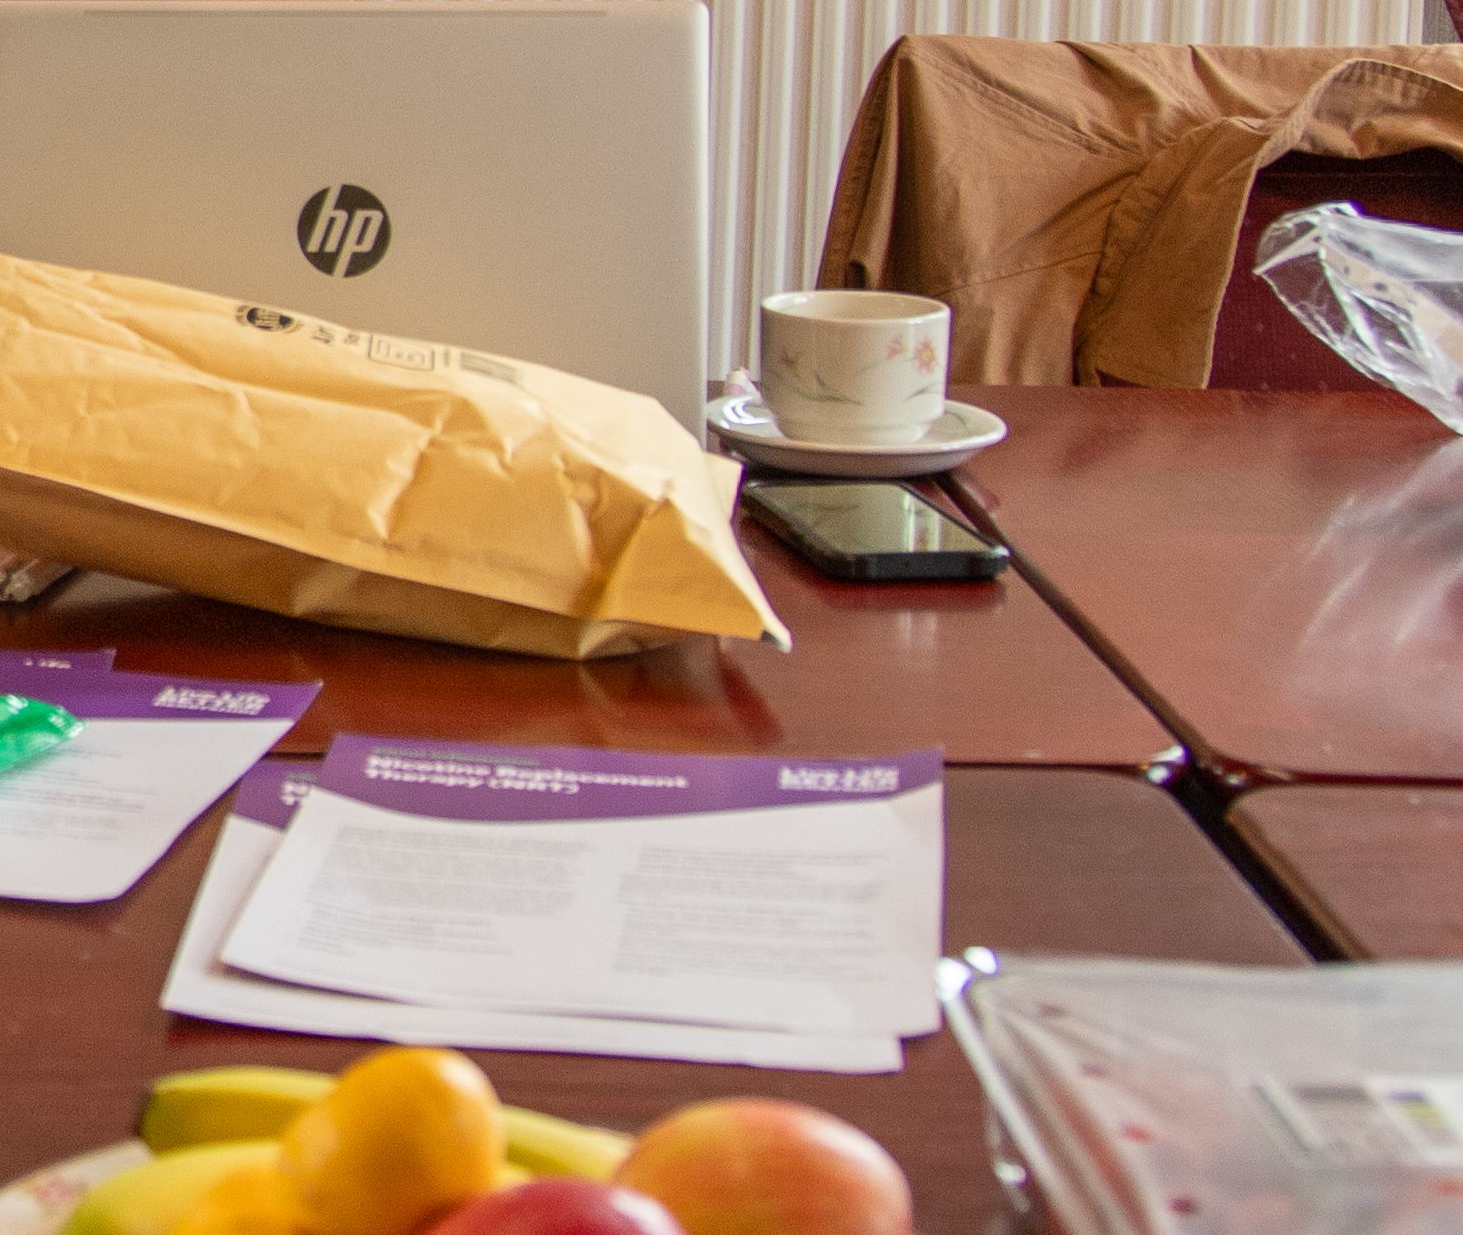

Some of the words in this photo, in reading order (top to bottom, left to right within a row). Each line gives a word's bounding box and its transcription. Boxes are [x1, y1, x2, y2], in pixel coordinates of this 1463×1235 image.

[303, 184, 387, 278] hp
[364, 766, 486, 789] Therapy
[489, 777, 580, 795] (NRT)
[366, 753, 491, 776] Nicotine
[495, 765, 689, 789] Replacement
